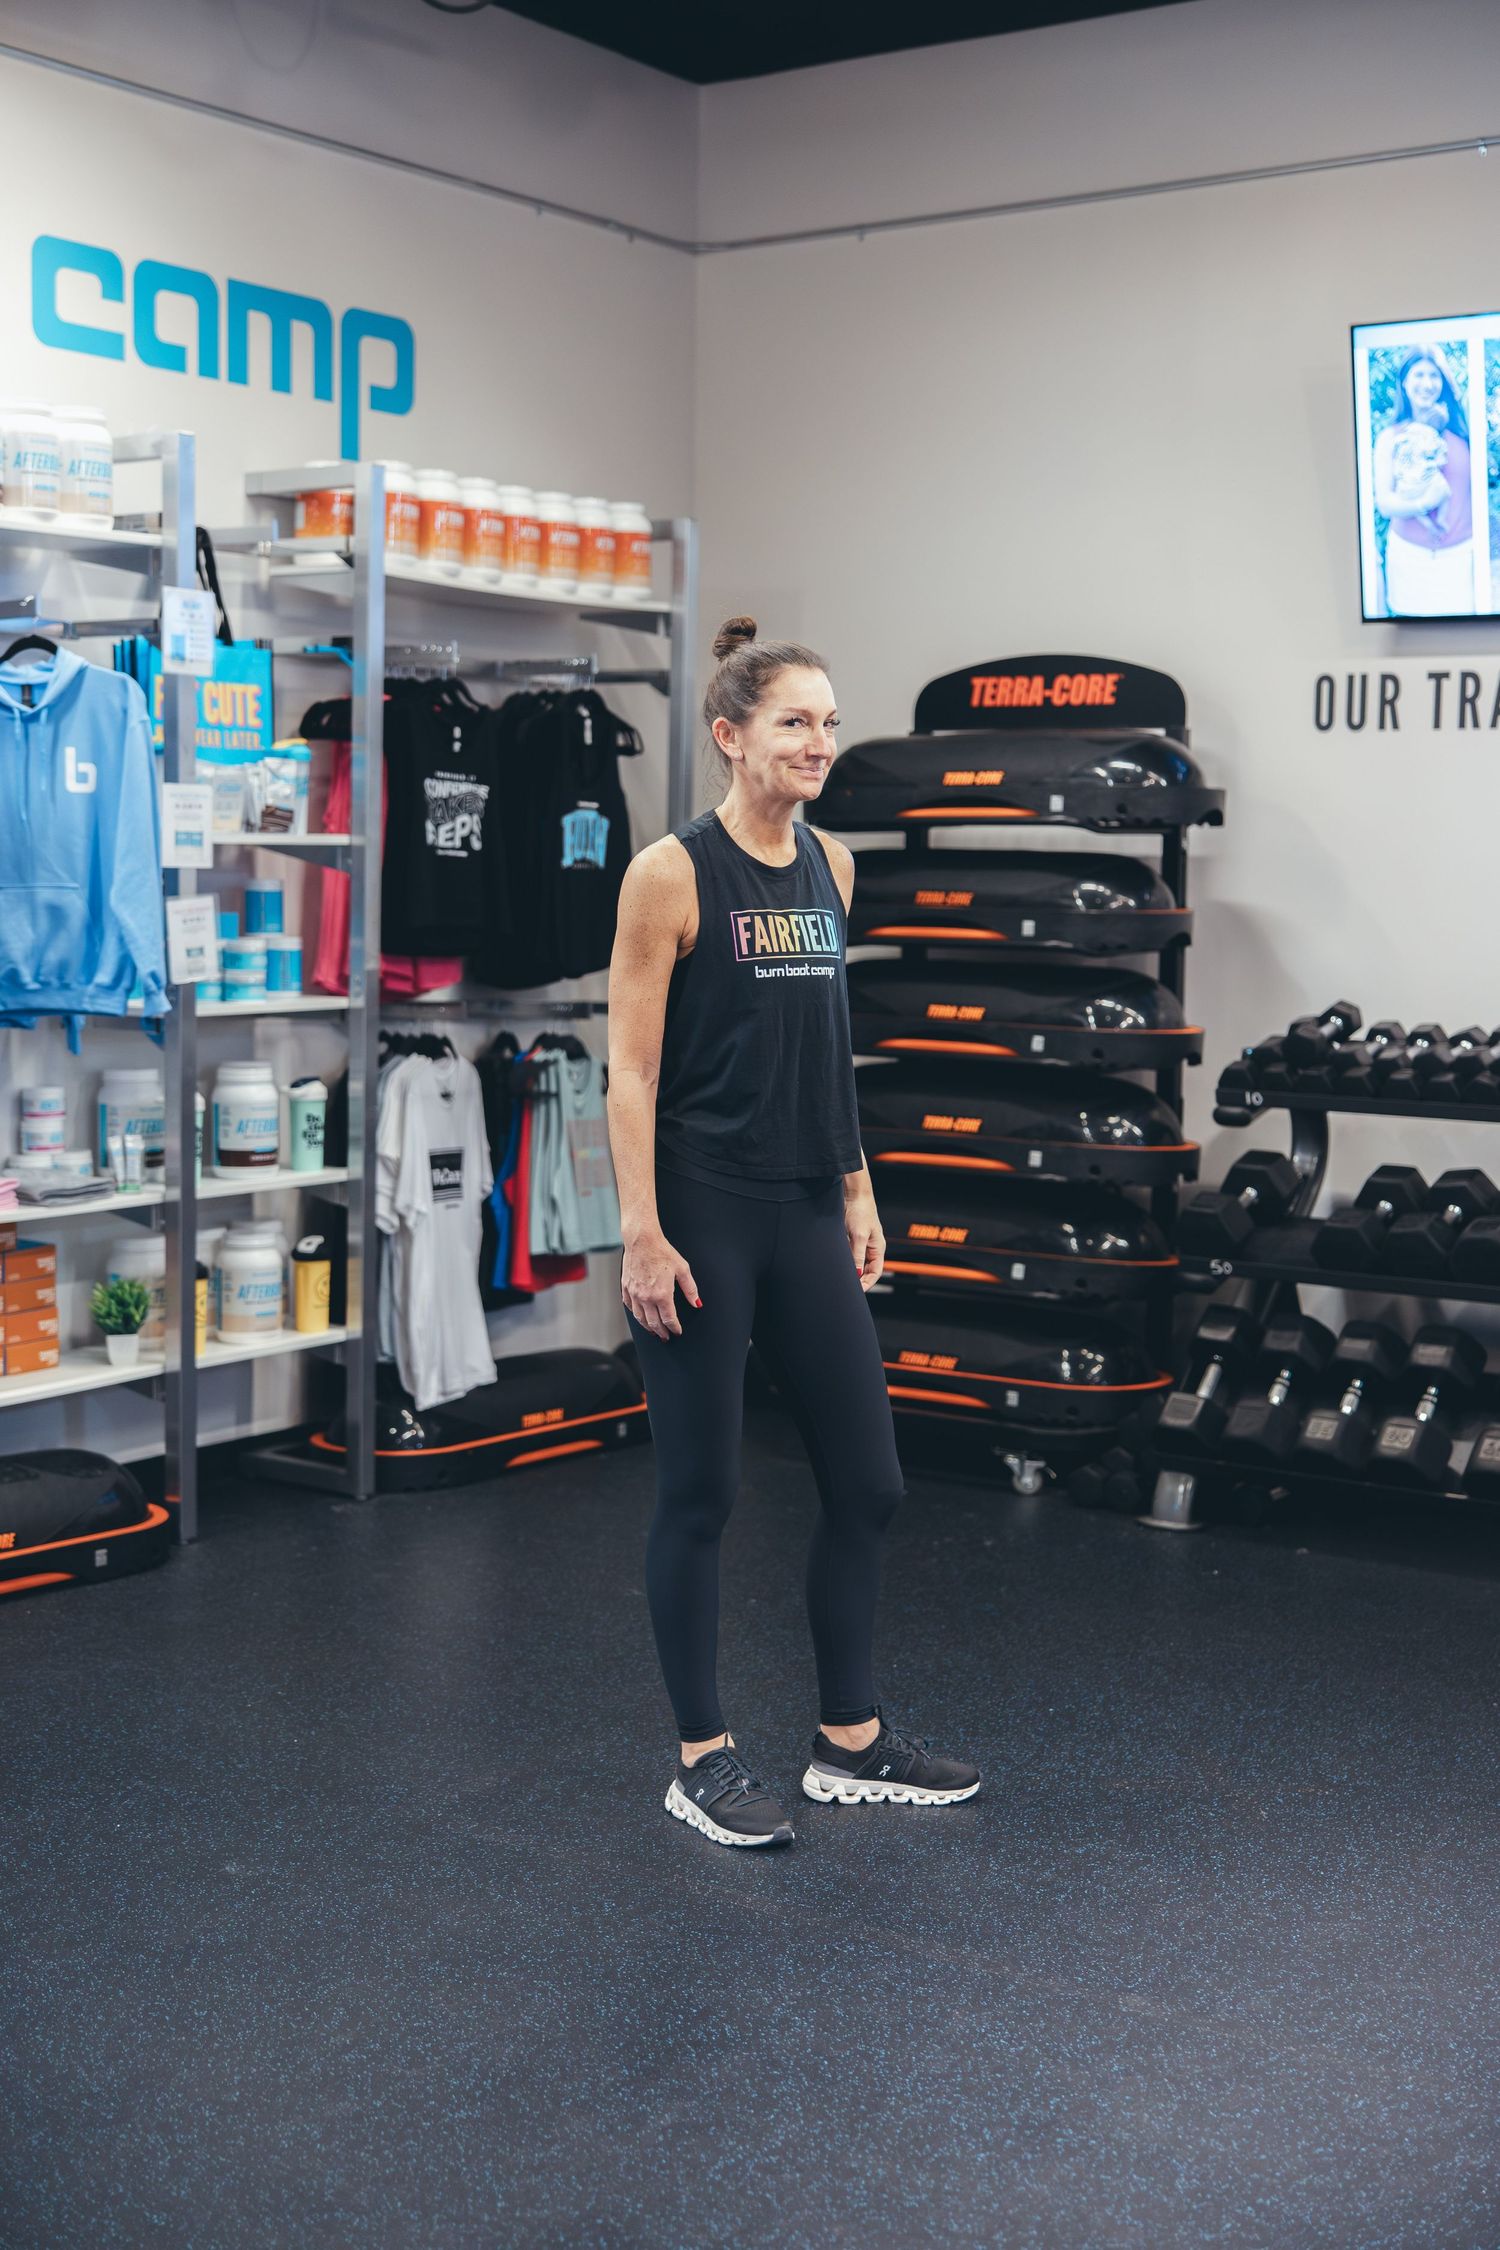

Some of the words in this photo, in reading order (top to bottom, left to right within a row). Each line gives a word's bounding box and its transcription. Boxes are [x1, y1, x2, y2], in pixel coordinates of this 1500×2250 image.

[32, 235, 415, 462] camp
[203, 681, 263, 727] CUTE
[970, 673, 1121, 707] TERRA-CORE
[1315, 673, 1400, 731] OUR
[737, 914, 838, 955] FAIRFIELD
[754, 965, 785, 979] burn
[785, 963, 811, 977] boot
[811, 965, 835, 979] camp
[1244, 1090, 1263, 1106] 10
[1209, 1258, 1233, 1275] 50
